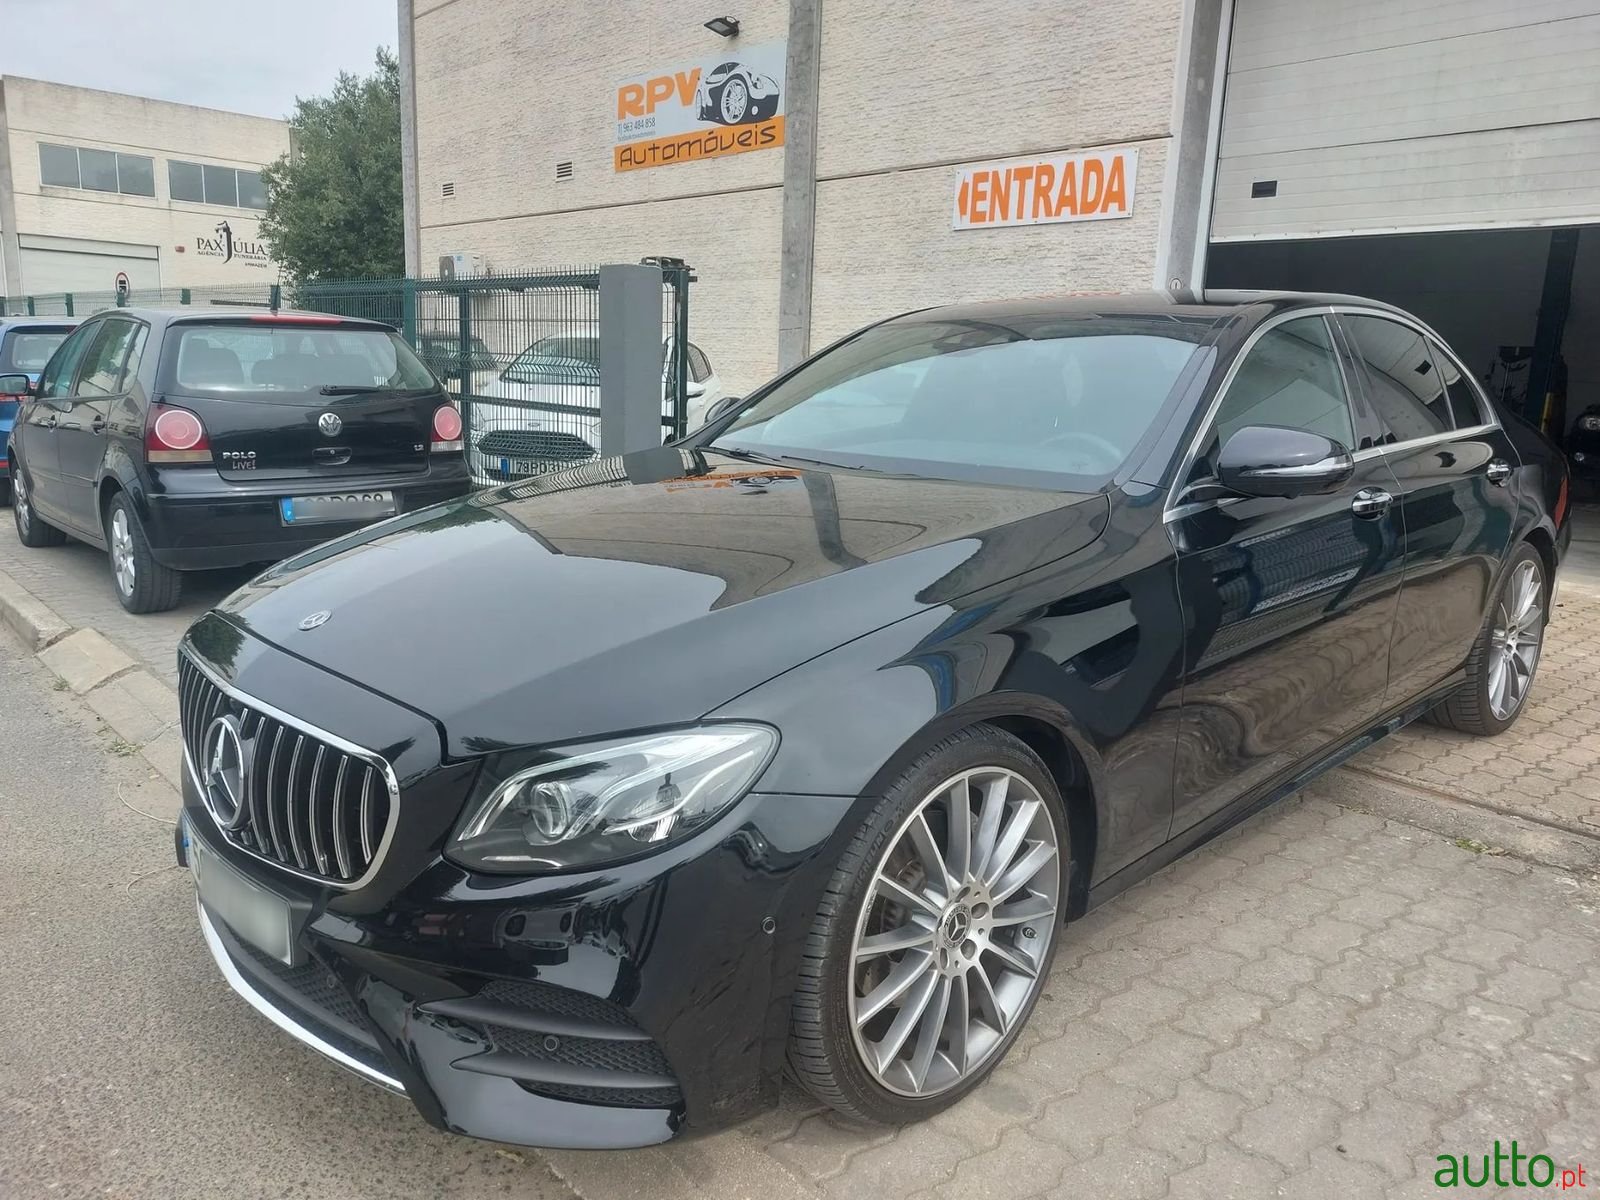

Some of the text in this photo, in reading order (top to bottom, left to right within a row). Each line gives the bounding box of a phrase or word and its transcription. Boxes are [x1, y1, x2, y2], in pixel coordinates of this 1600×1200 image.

[617, 67, 702, 120] RPV
[619, 124, 777, 168] Automóveis
[969, 155, 1127, 224] ENTRADA
[196, 237, 224, 252] PAX
[222, 451, 257, 460] POLO
[232, 460, 257, 470] LIVE!
